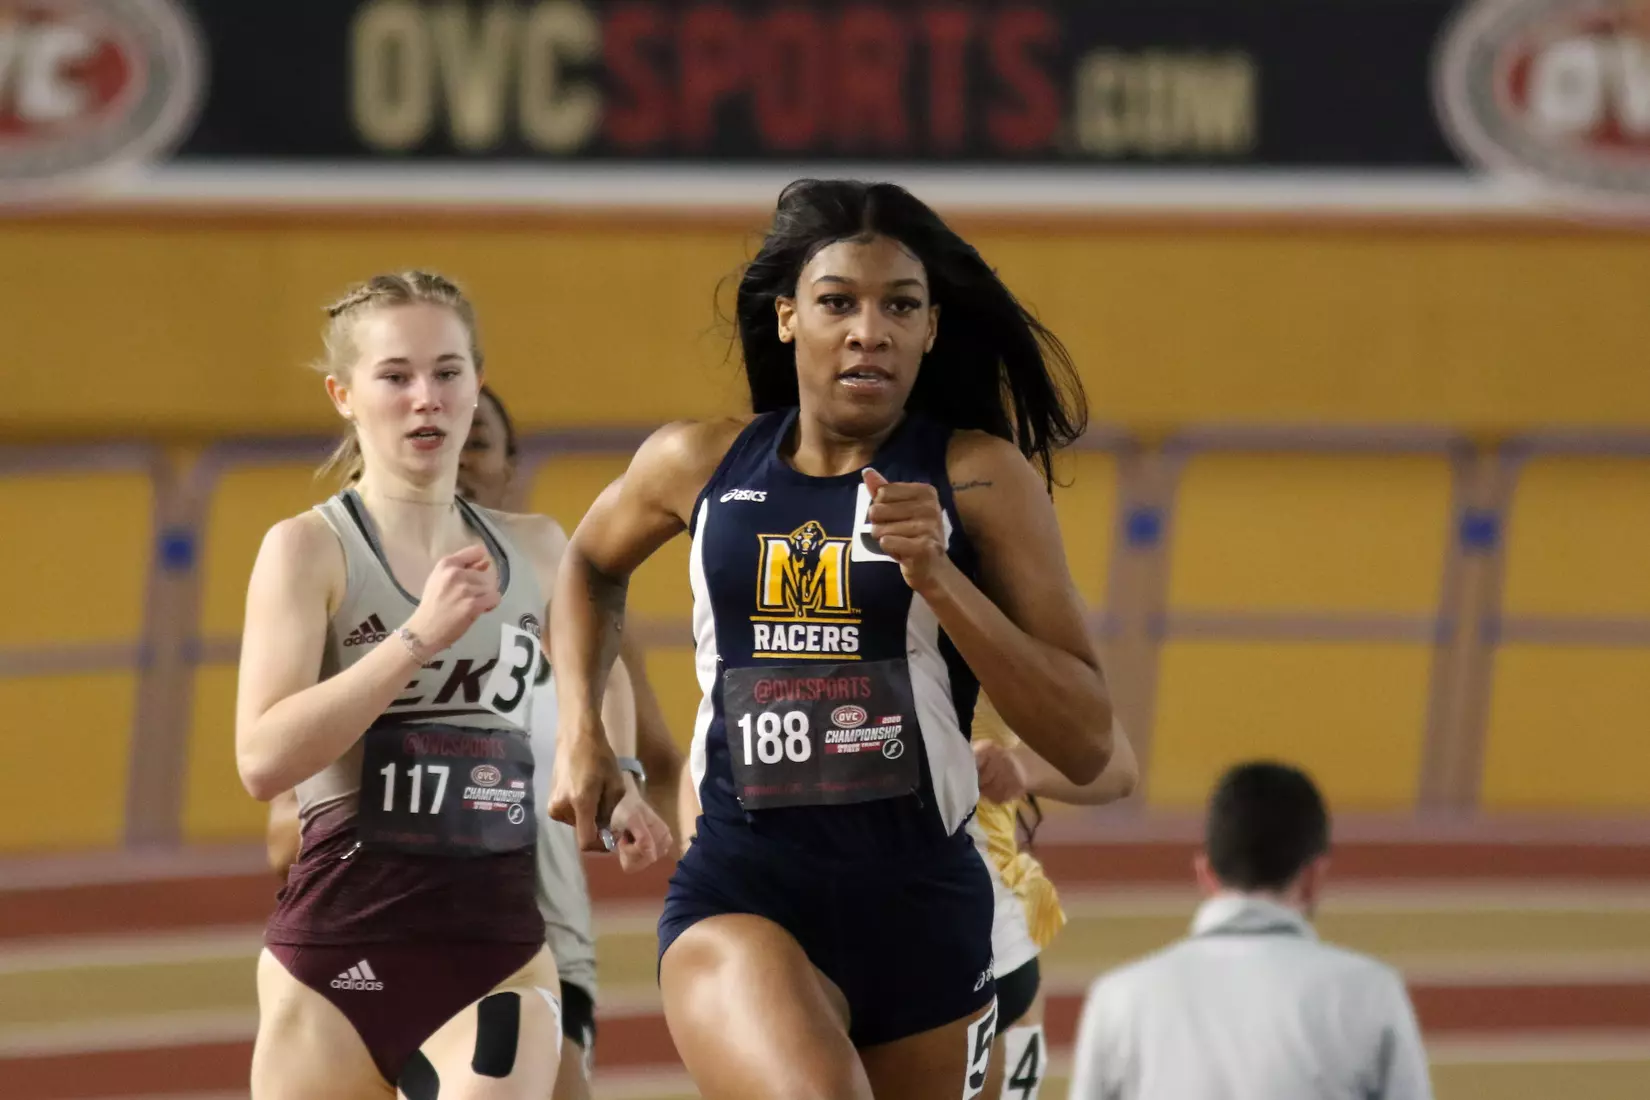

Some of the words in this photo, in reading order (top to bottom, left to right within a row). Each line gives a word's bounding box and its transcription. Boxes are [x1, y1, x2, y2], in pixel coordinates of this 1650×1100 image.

[720, 489, 767, 503] asics
[757, 534, 851, 613] M
[342, 631, 391, 647] adida
[753, 624, 859, 652] RACERS
[491, 634, 534, 714] 3
[754, 677, 872, 704] @OVCSPORTS
[838, 712, 860, 722] OVC
[738, 711, 811, 765] 188
[825, 725, 902, 743] CHAMPIONSHIP
[380, 763, 450, 814] 117
[330, 977, 384, 991] adidas
[1008, 1032, 1040, 1100] 4
